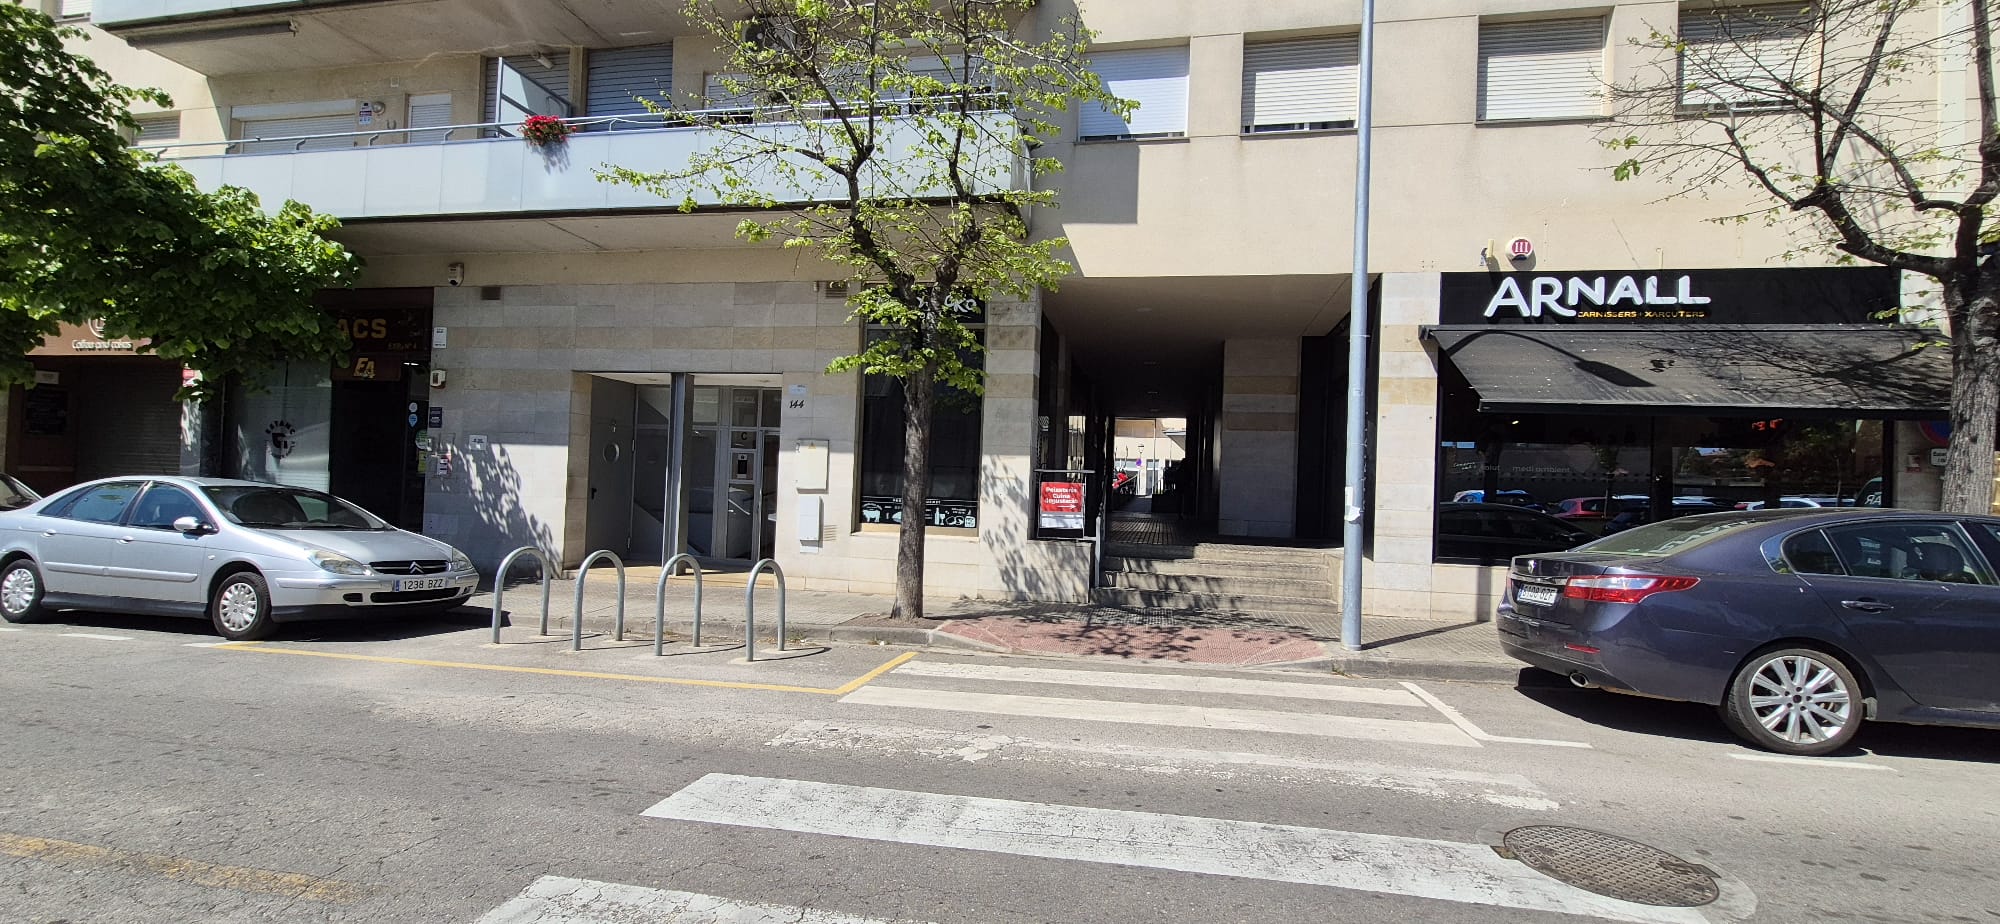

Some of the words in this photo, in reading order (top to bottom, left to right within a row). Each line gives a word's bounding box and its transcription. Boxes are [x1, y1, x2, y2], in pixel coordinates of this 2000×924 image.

[1483, 275, 1711, 317] ARNALL
[789, 400, 805, 409] 144
[404, 580, 424, 589] 1238
[428, 578, 443, 588] BZZ
